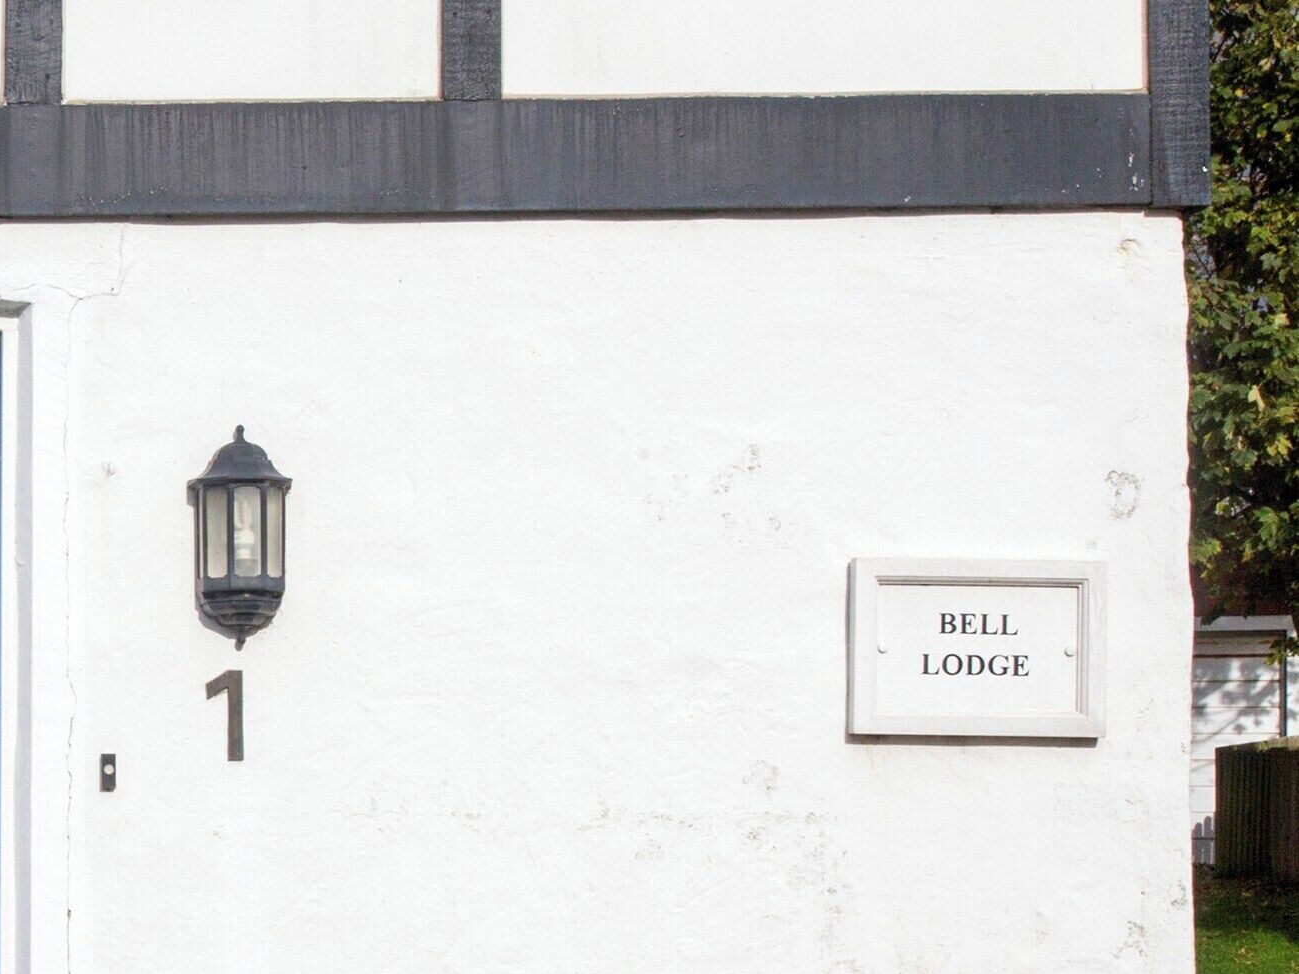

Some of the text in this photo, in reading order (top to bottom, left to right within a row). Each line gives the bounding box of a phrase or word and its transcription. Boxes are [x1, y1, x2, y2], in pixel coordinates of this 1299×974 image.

[939, 613, 1018, 635] BELL
[921, 653, 1030, 676] LODGE
[205, 670, 244, 761] 1
